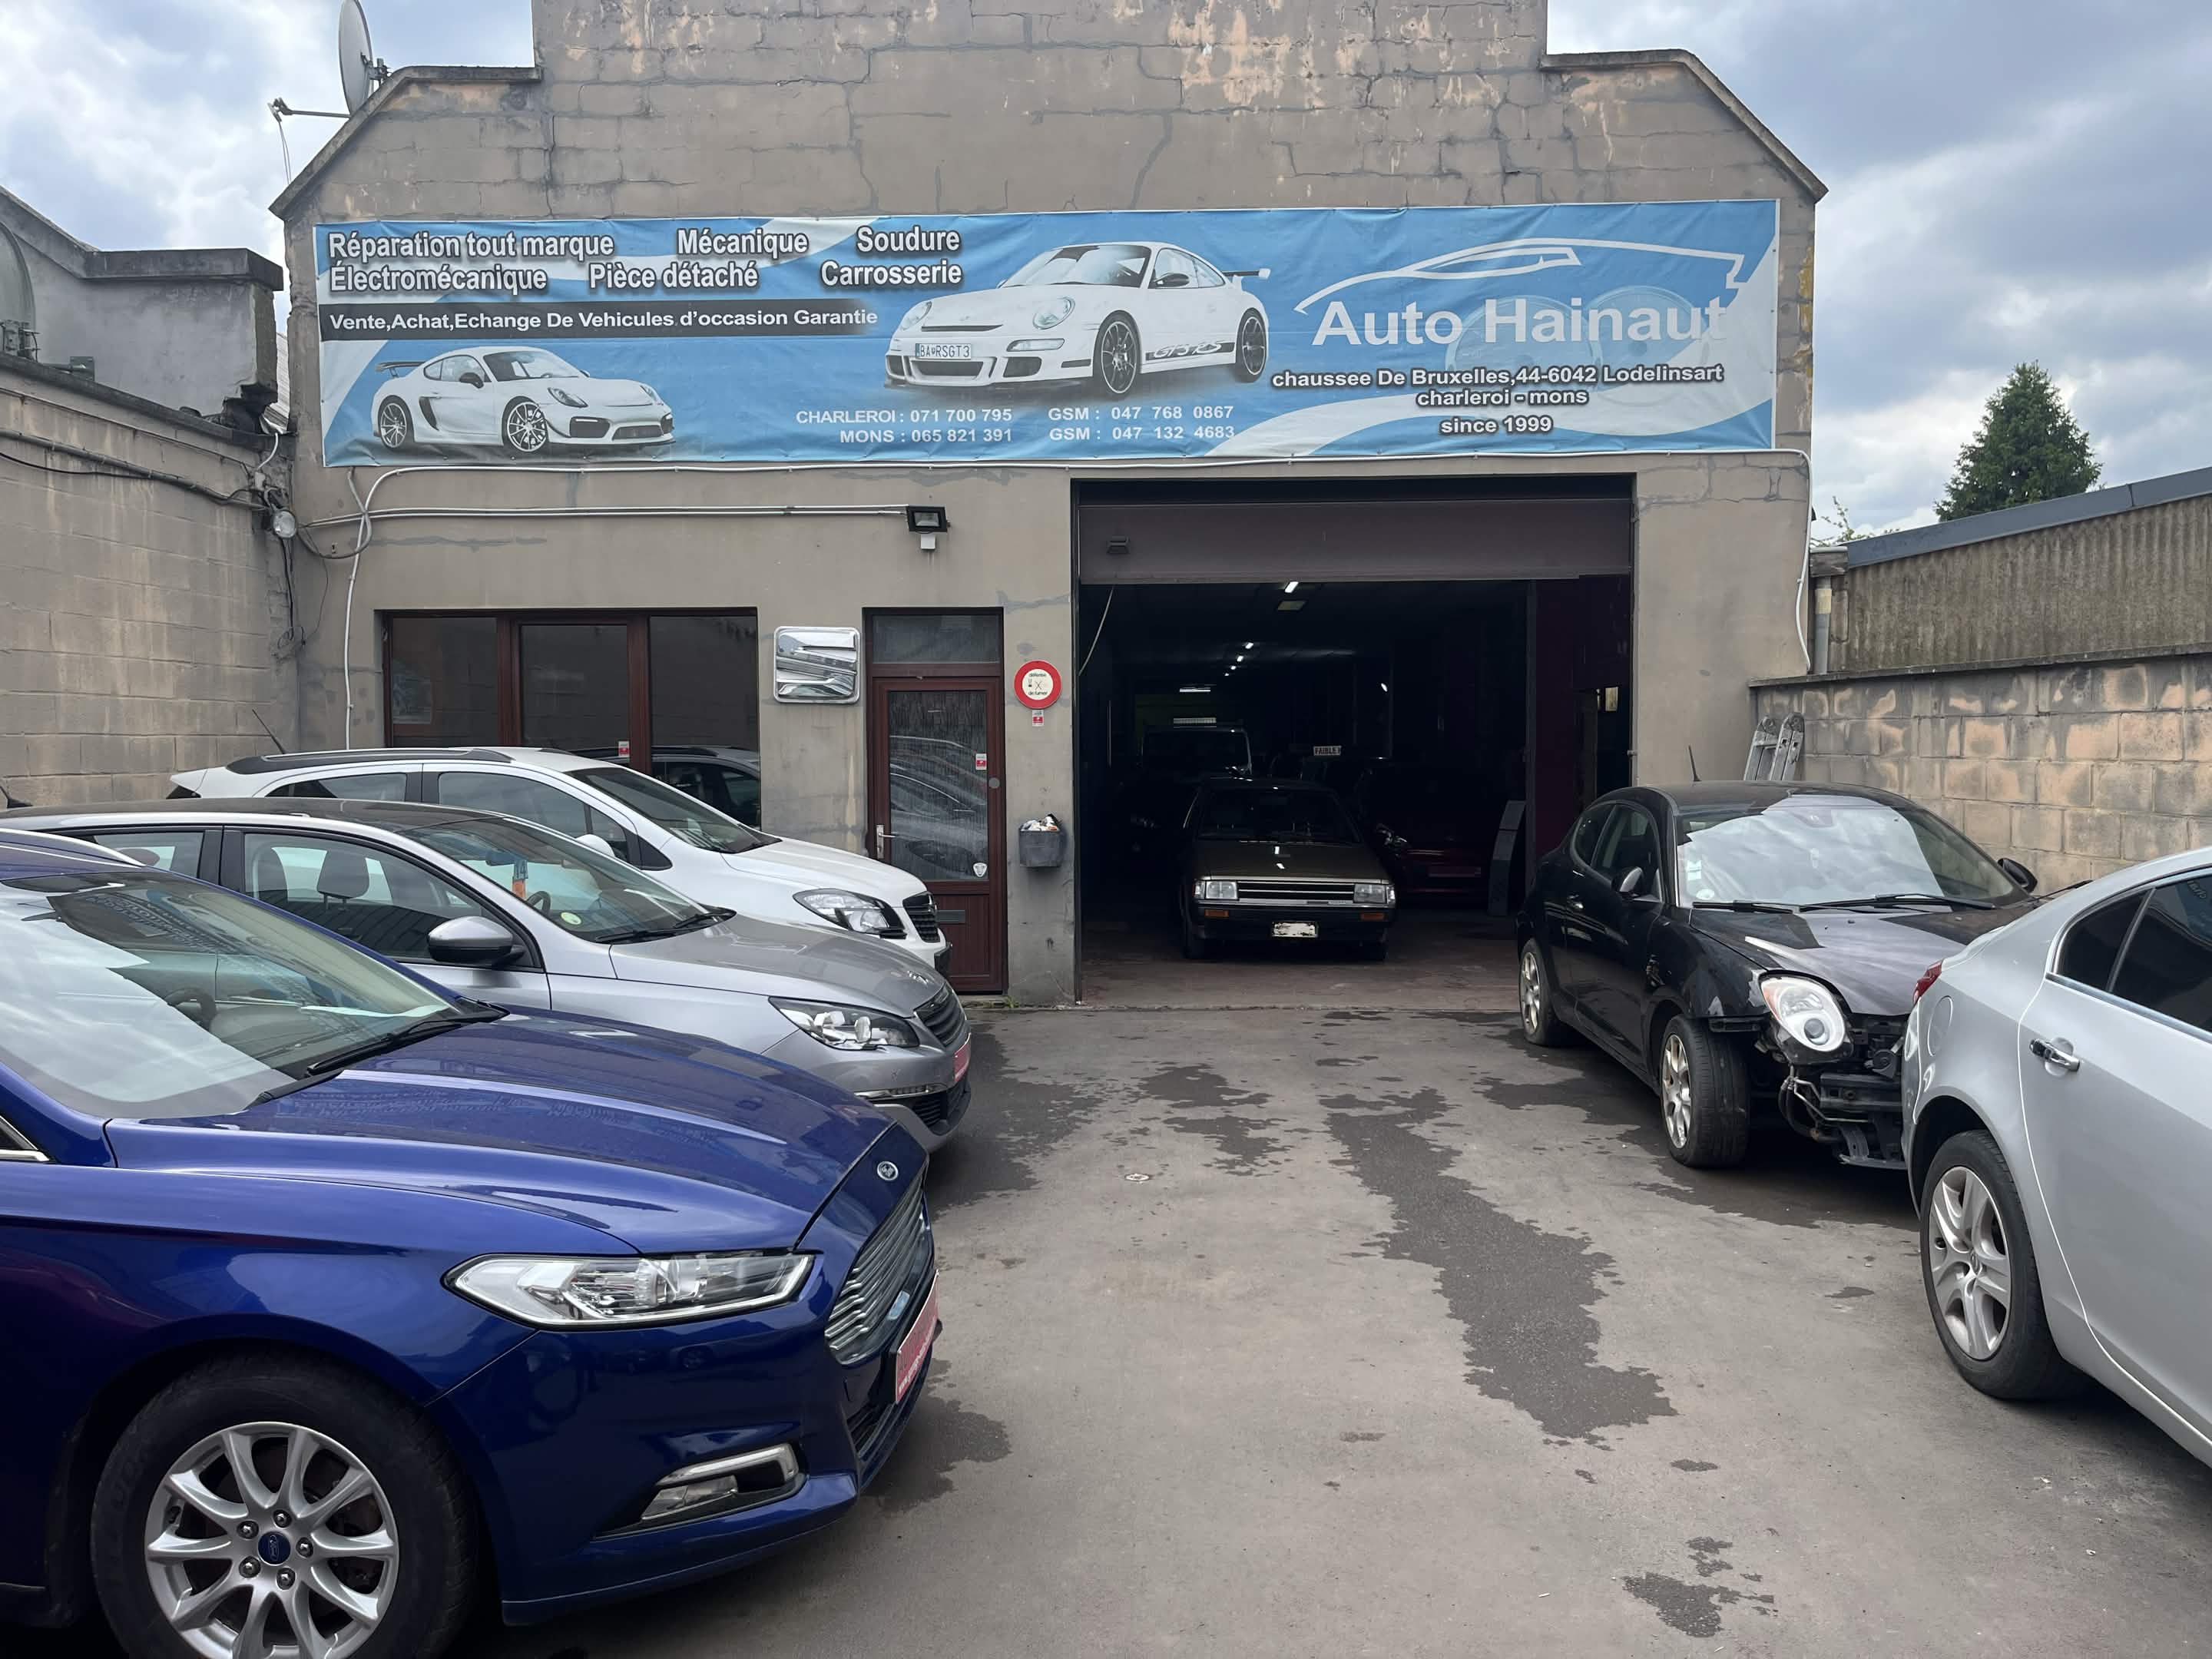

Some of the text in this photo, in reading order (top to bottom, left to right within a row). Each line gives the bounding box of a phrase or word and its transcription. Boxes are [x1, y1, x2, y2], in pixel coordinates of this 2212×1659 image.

[329, 233, 614, 263] Réparation tout marque
[677, 228, 808, 258] Mécanique
[856, 226, 960, 252] Soudure
[329, 261, 758, 295] Électromécanique Pièce détaché
[820, 260, 962, 286] Carrosserie
[329, 309, 879, 331] Vente,Achat,Echange De Vehicules d'occasion Garantie
[1312, 296, 1727, 346] Auto Hainaut
[1272, 364, 1725, 387] chaussee De Bruxelles,44-6042 Lodelinsart
[1416, 388, 1510, 407] charleroi
[1529, 389, 1589, 406] mons
[796, 409, 896, 424] CHARLEROI
[910, 409, 939, 423] 071
[945, 409, 975, 422] 700
[982, 408, 1012, 422] 795
[1048, 406, 1091, 422] GSM
[1111, 406, 1141, 420] 047
[1153, 406, 1183, 419] 768
[1193, 405, 1234, 419] 0867
[839, 429, 895, 443] MONS
[911, 429, 942, 443] 065
[946, 429, 976, 442] 821
[982, 428, 1012, 442] 391
[1049, 426, 1091, 441] GSM
[1111, 426, 1142, 440] 047
[1154, 426, 1184, 439] 132
[1194, 425, 1235, 439] 4683
[1439, 416, 1554, 435] since 1999
